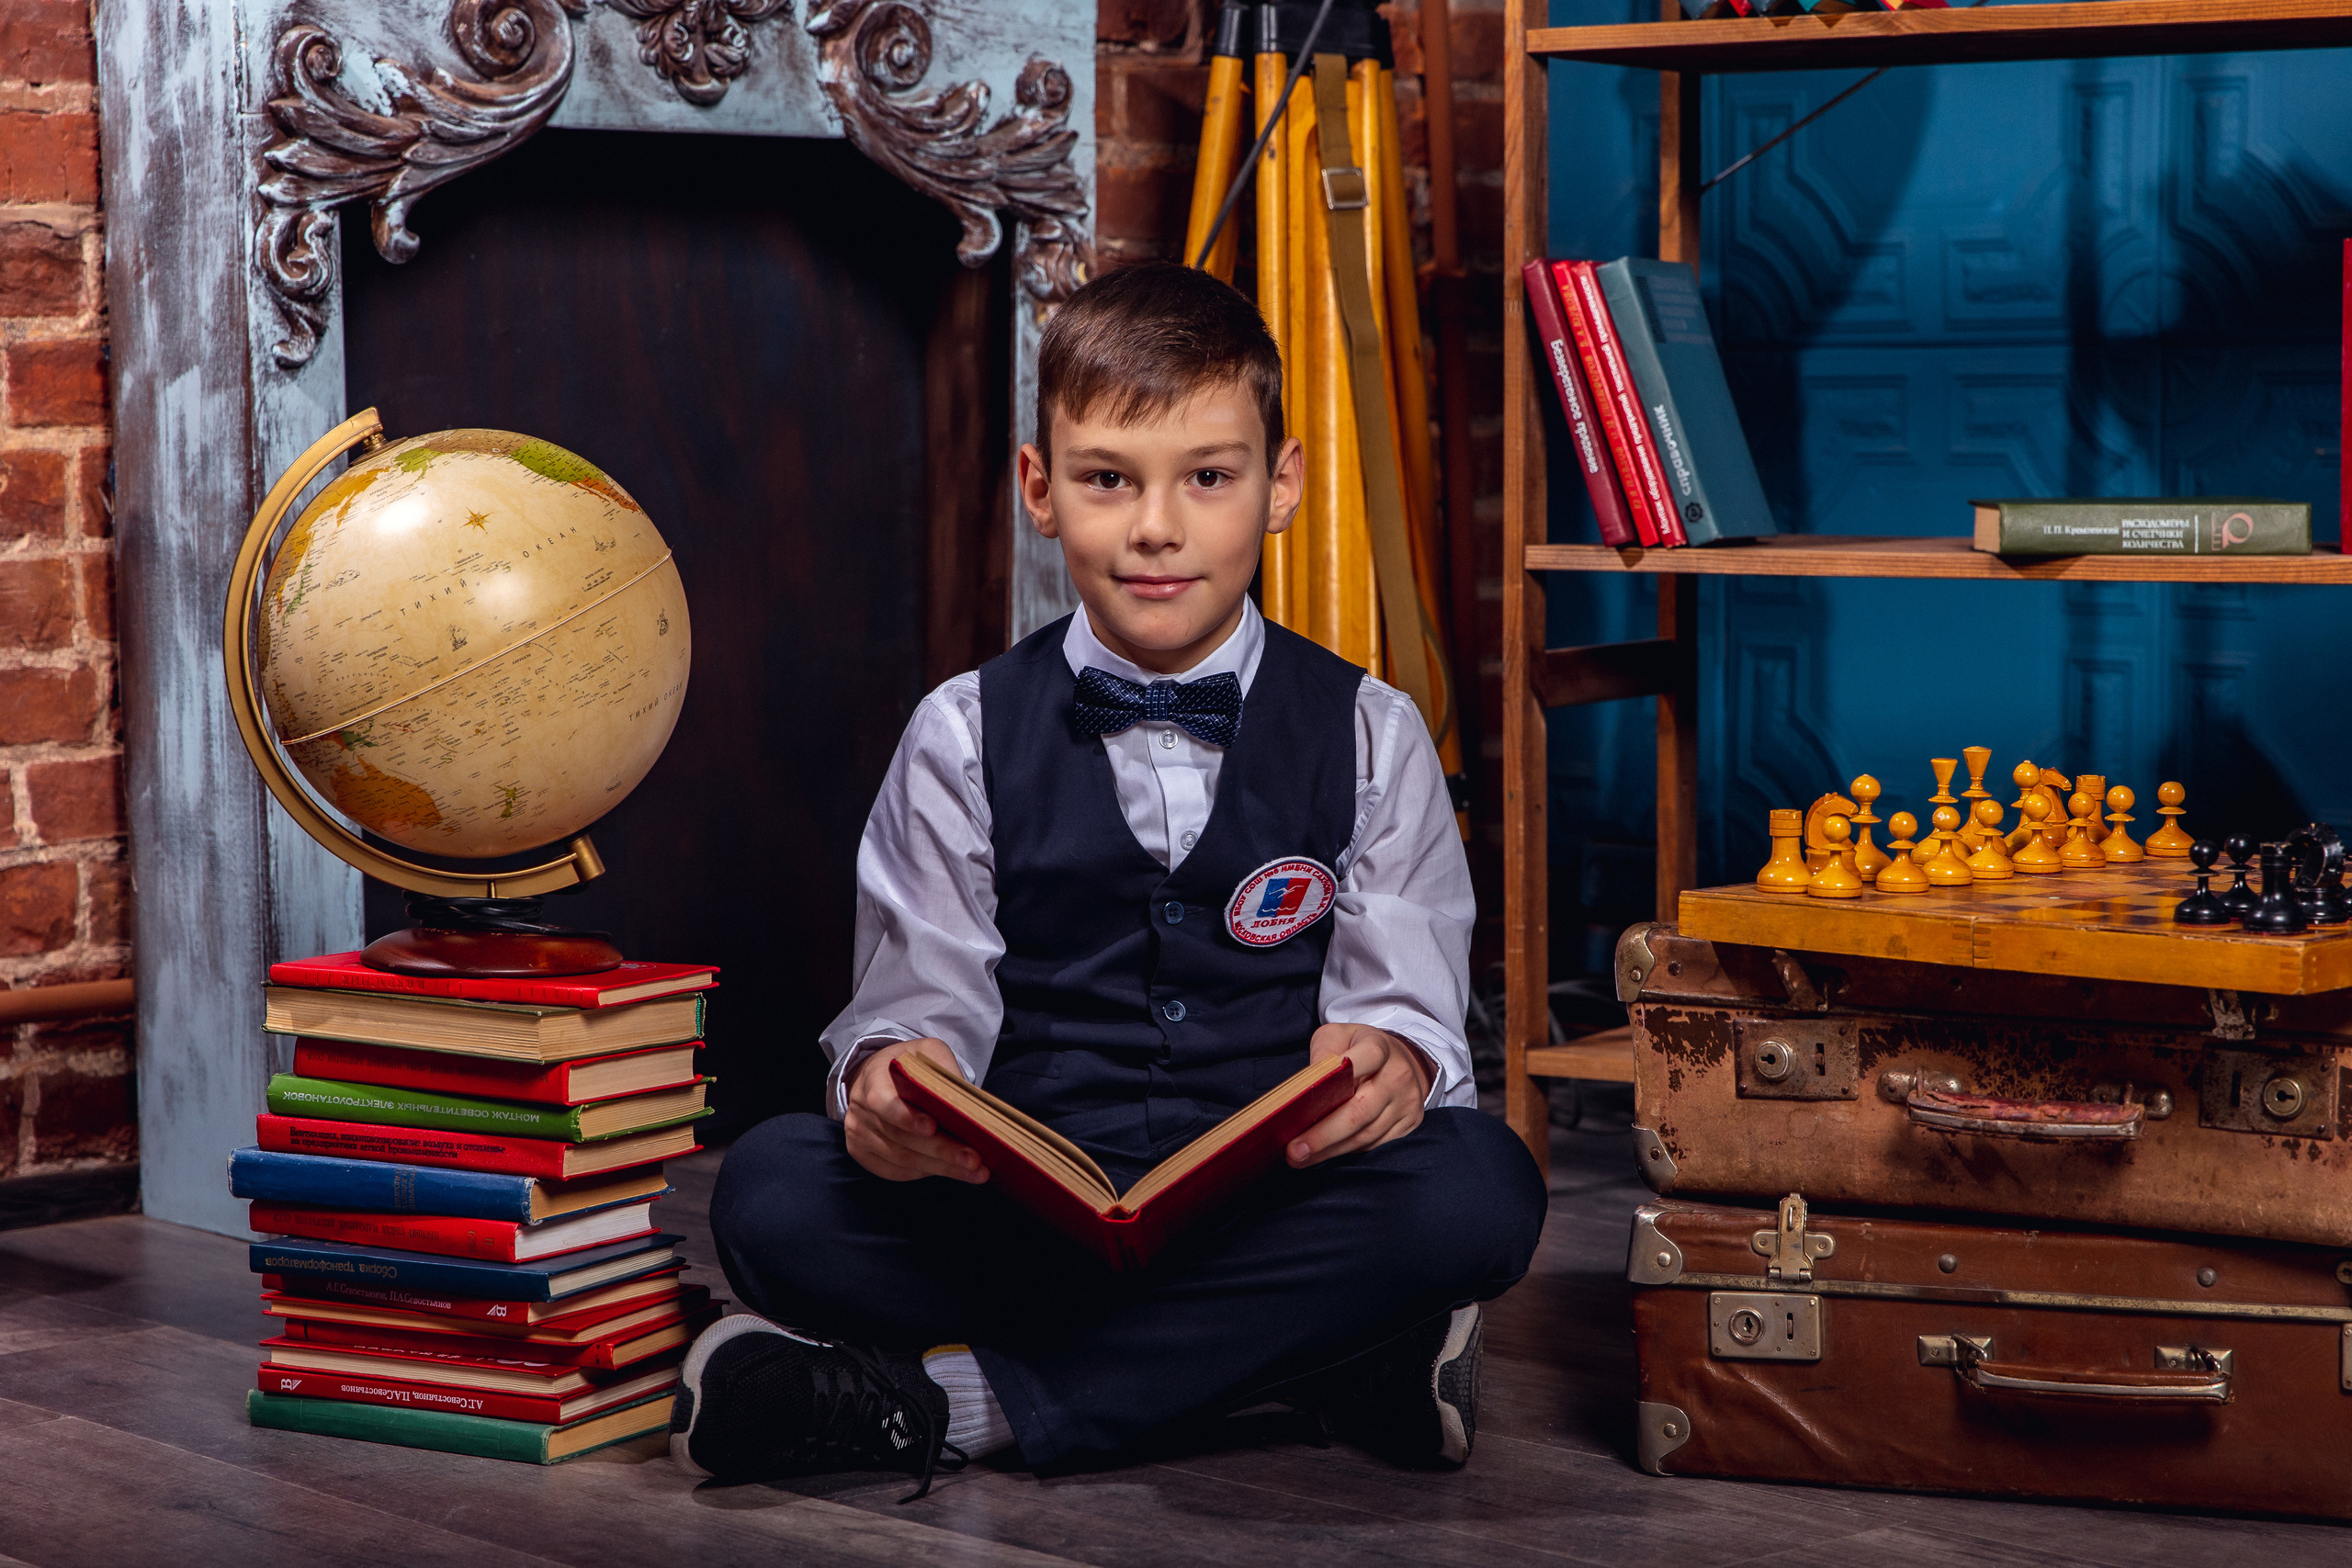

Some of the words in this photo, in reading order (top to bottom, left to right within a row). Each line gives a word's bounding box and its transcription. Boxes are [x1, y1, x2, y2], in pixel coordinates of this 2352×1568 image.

[1550, 339, 1582, 421] Безверетенное
[1575, 421, 1600, 474] прядение
[1654, 404, 1691, 496] справочник
[1245, 876, 1264, 895] СОШ
[1282, 864, 1314, 874] ИМЕНИ
[1234, 920, 1278, 942] МОСКОВСКАЯ
[1280, 912, 1318, 939] ОБЛАСТЬ
[1250, 917, 1297, 929] ЛОБНЯ
[283, 1091, 394, 1110] ЭЛЕКТРОУСТАНОВОК
[397, 1102, 489, 1119] ОСВЕТИТЕЛЬНЫХ
[492, 1110, 539, 1123] МОНТАЖ
[273, 1212, 291, 1223] СССР
[266, 1257, 356, 1273] трансформаторов
[359, 1263, 397, 1279] Сборка
